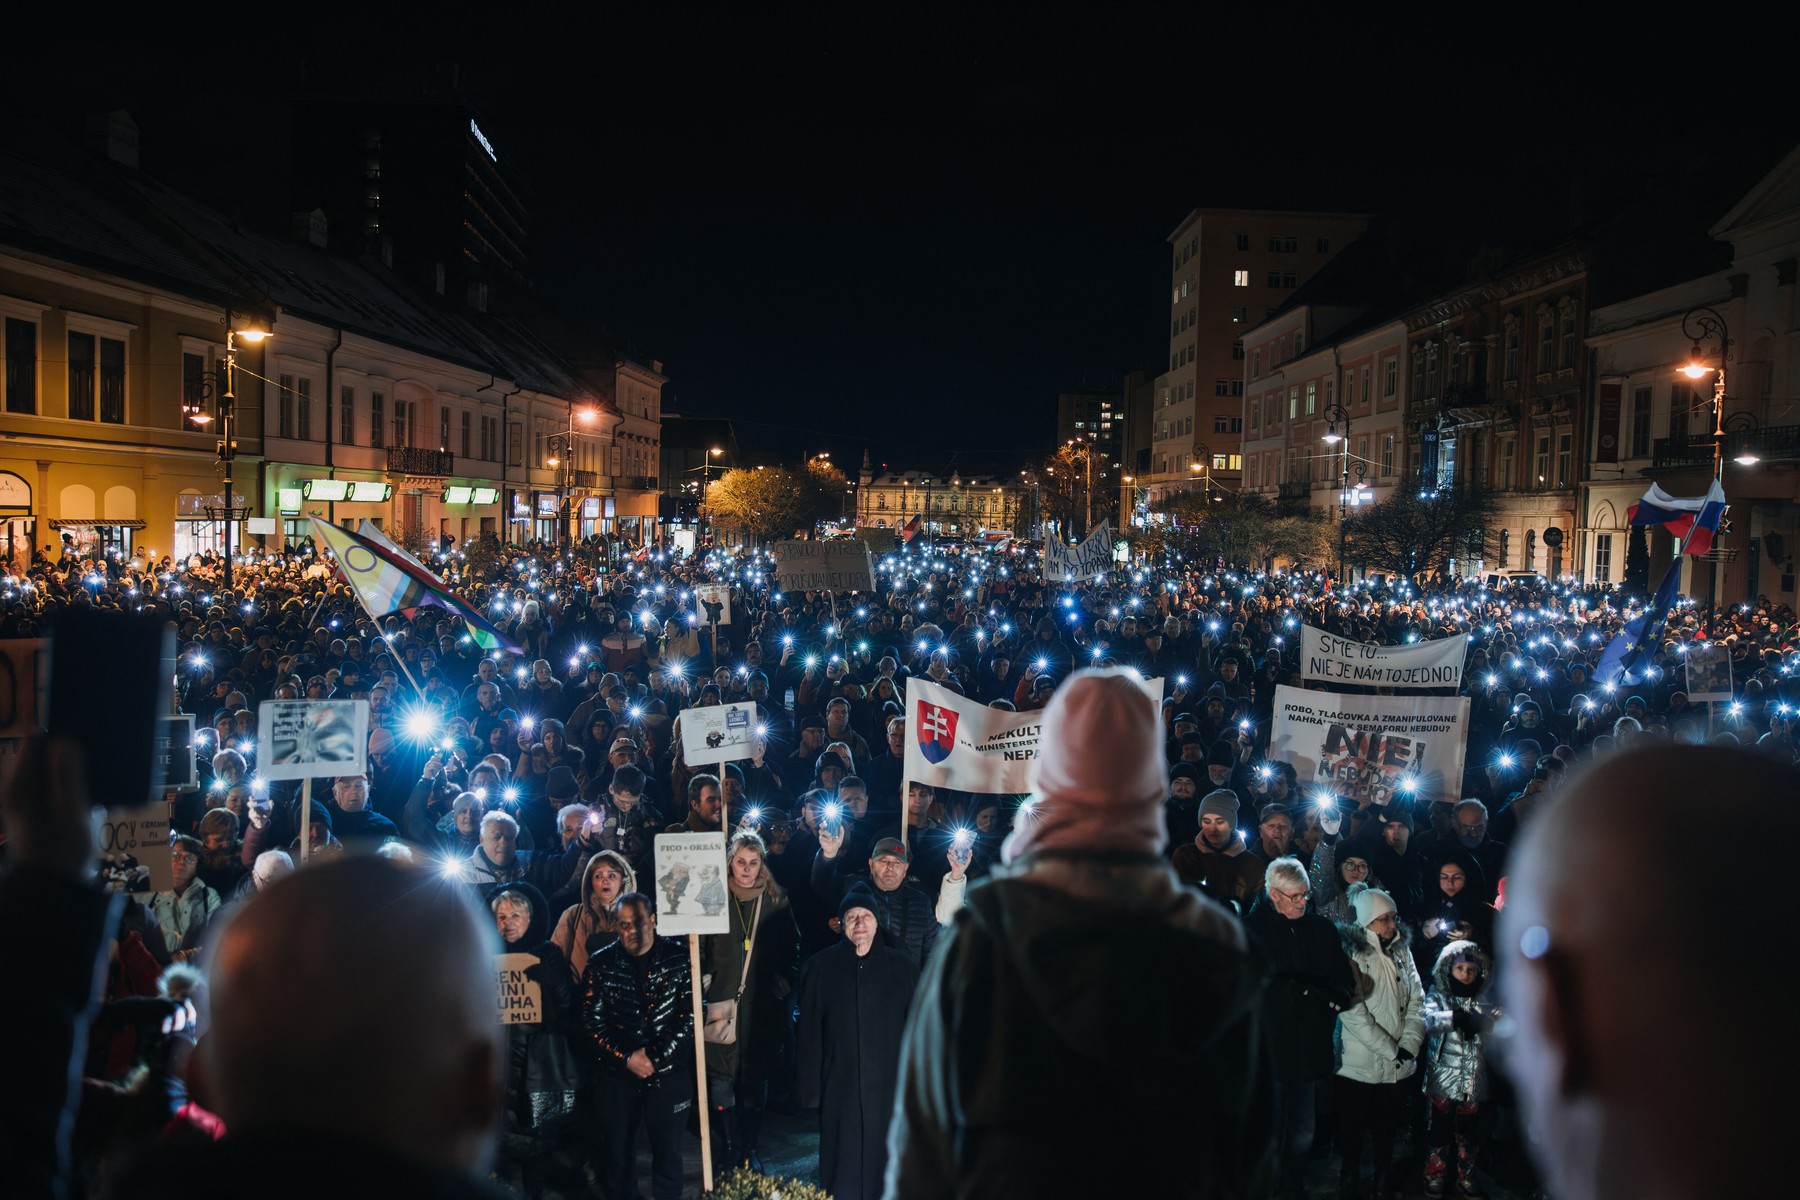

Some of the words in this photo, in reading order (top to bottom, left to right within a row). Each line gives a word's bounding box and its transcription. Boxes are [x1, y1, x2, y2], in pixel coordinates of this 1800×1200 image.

[1319, 635, 1353, 658] SME
[1359, 646, 1388, 660] TU...
[1310, 656, 1334, 676] NIE
[1335, 661, 1353, 678] JE
[1353, 664, 1382, 681] NÁM
[1385, 668, 1402, 682] TO
[1402, 666, 1459, 683] JEDNO!
[1284, 703, 1315, 716] ROBO,
[1318, 709, 1371, 722] TLAČOVKA
[1382, 713, 1457, 724] ZMANIPULOVANÉ
[1325, 724, 1426, 775] NIE!
[660, 844, 682, 852] FICO
[689, 842, 722, 851] ORBÁN
[510, 1011, 537, 1022] MU!
